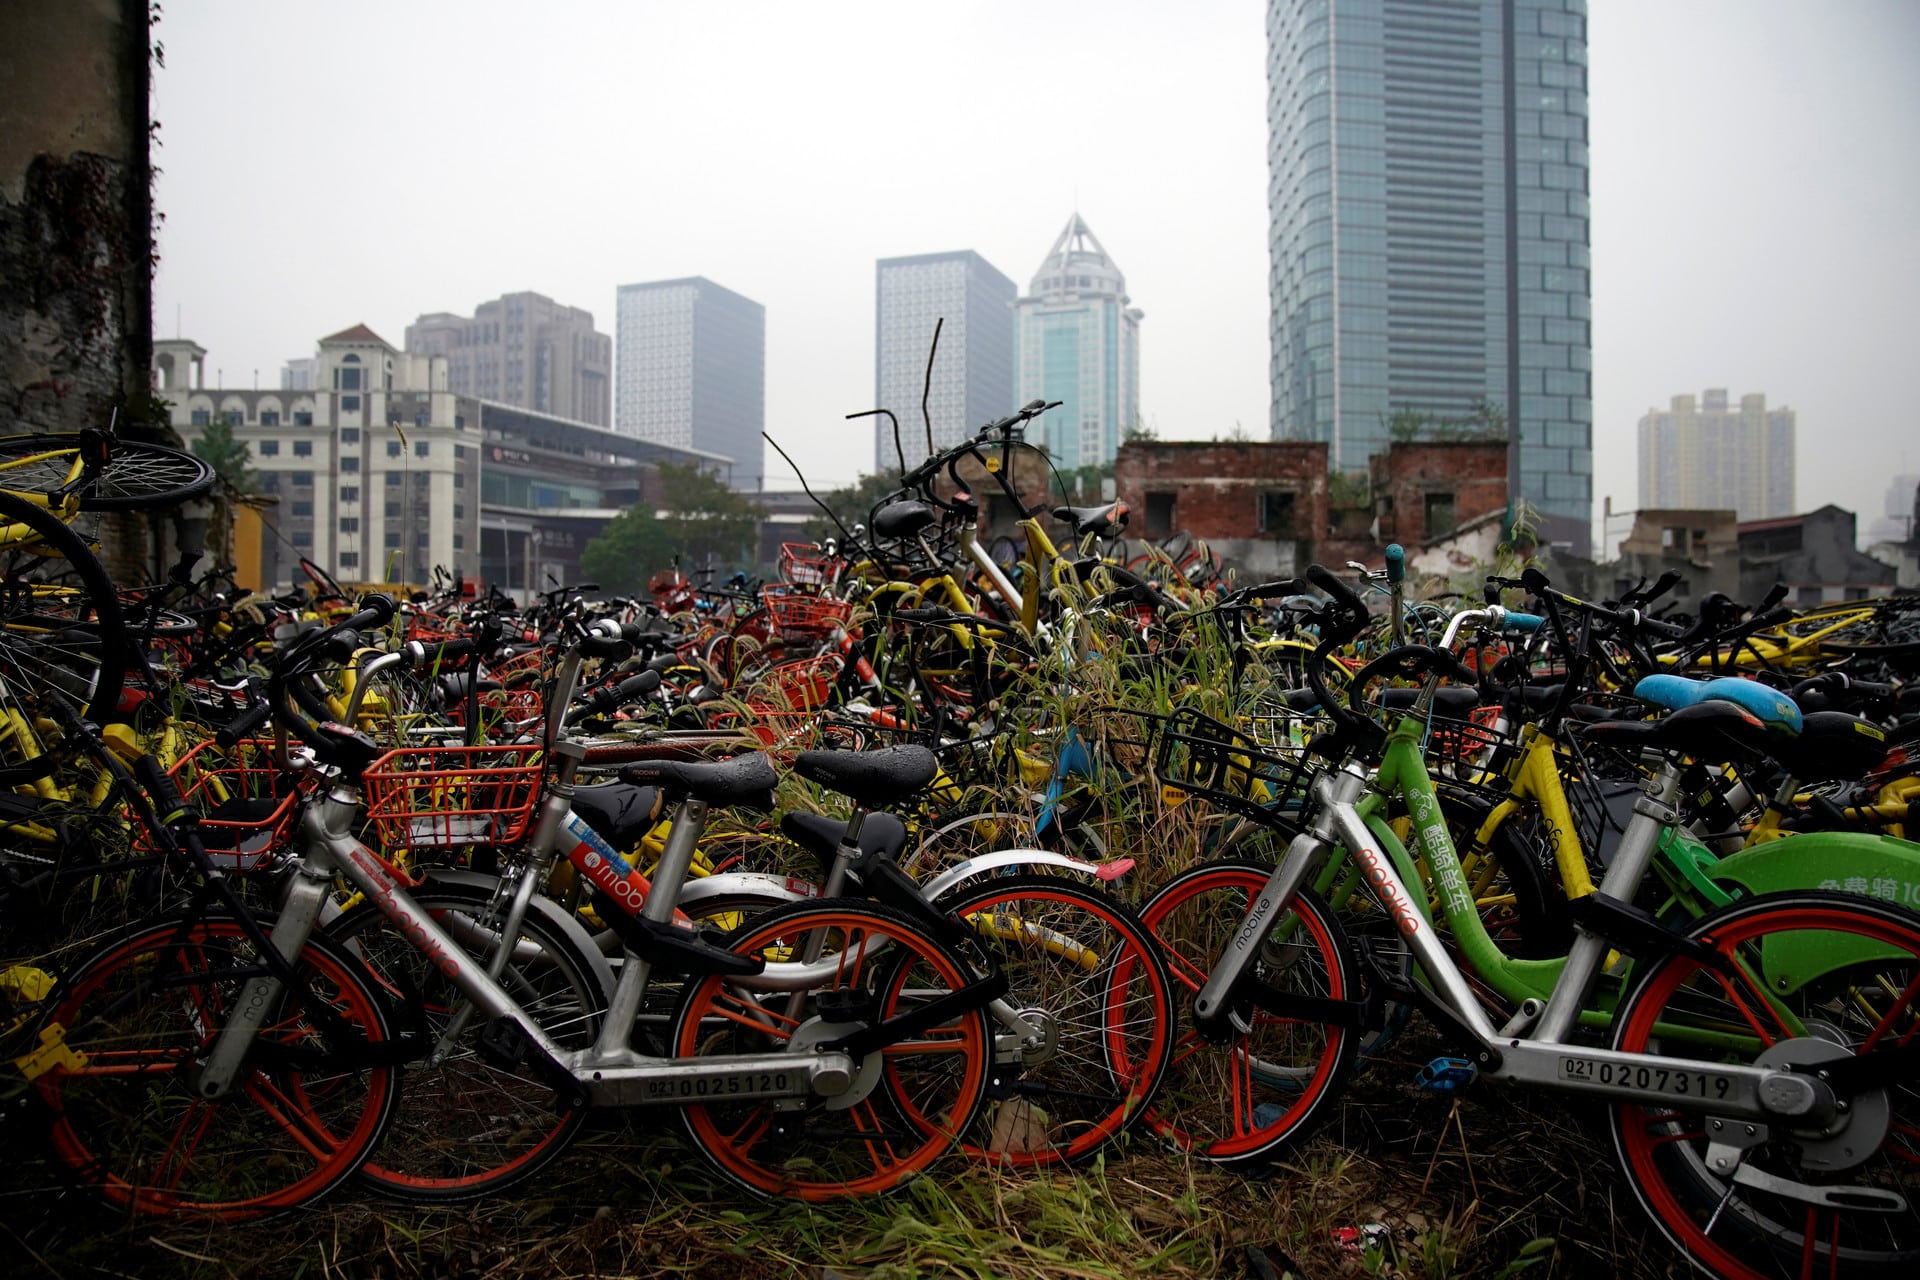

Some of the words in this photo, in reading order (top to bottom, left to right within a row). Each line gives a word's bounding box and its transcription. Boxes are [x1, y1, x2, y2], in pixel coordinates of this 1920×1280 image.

[597, 865, 644, 908] mob
[1356, 849, 1419, 936] mobike
[1422, 823, 1469, 916] 酷骑单车
[372, 890, 460, 977] mobike
[1236, 898, 1270, 950] mobike
[243, 979, 273, 1021] mobi
